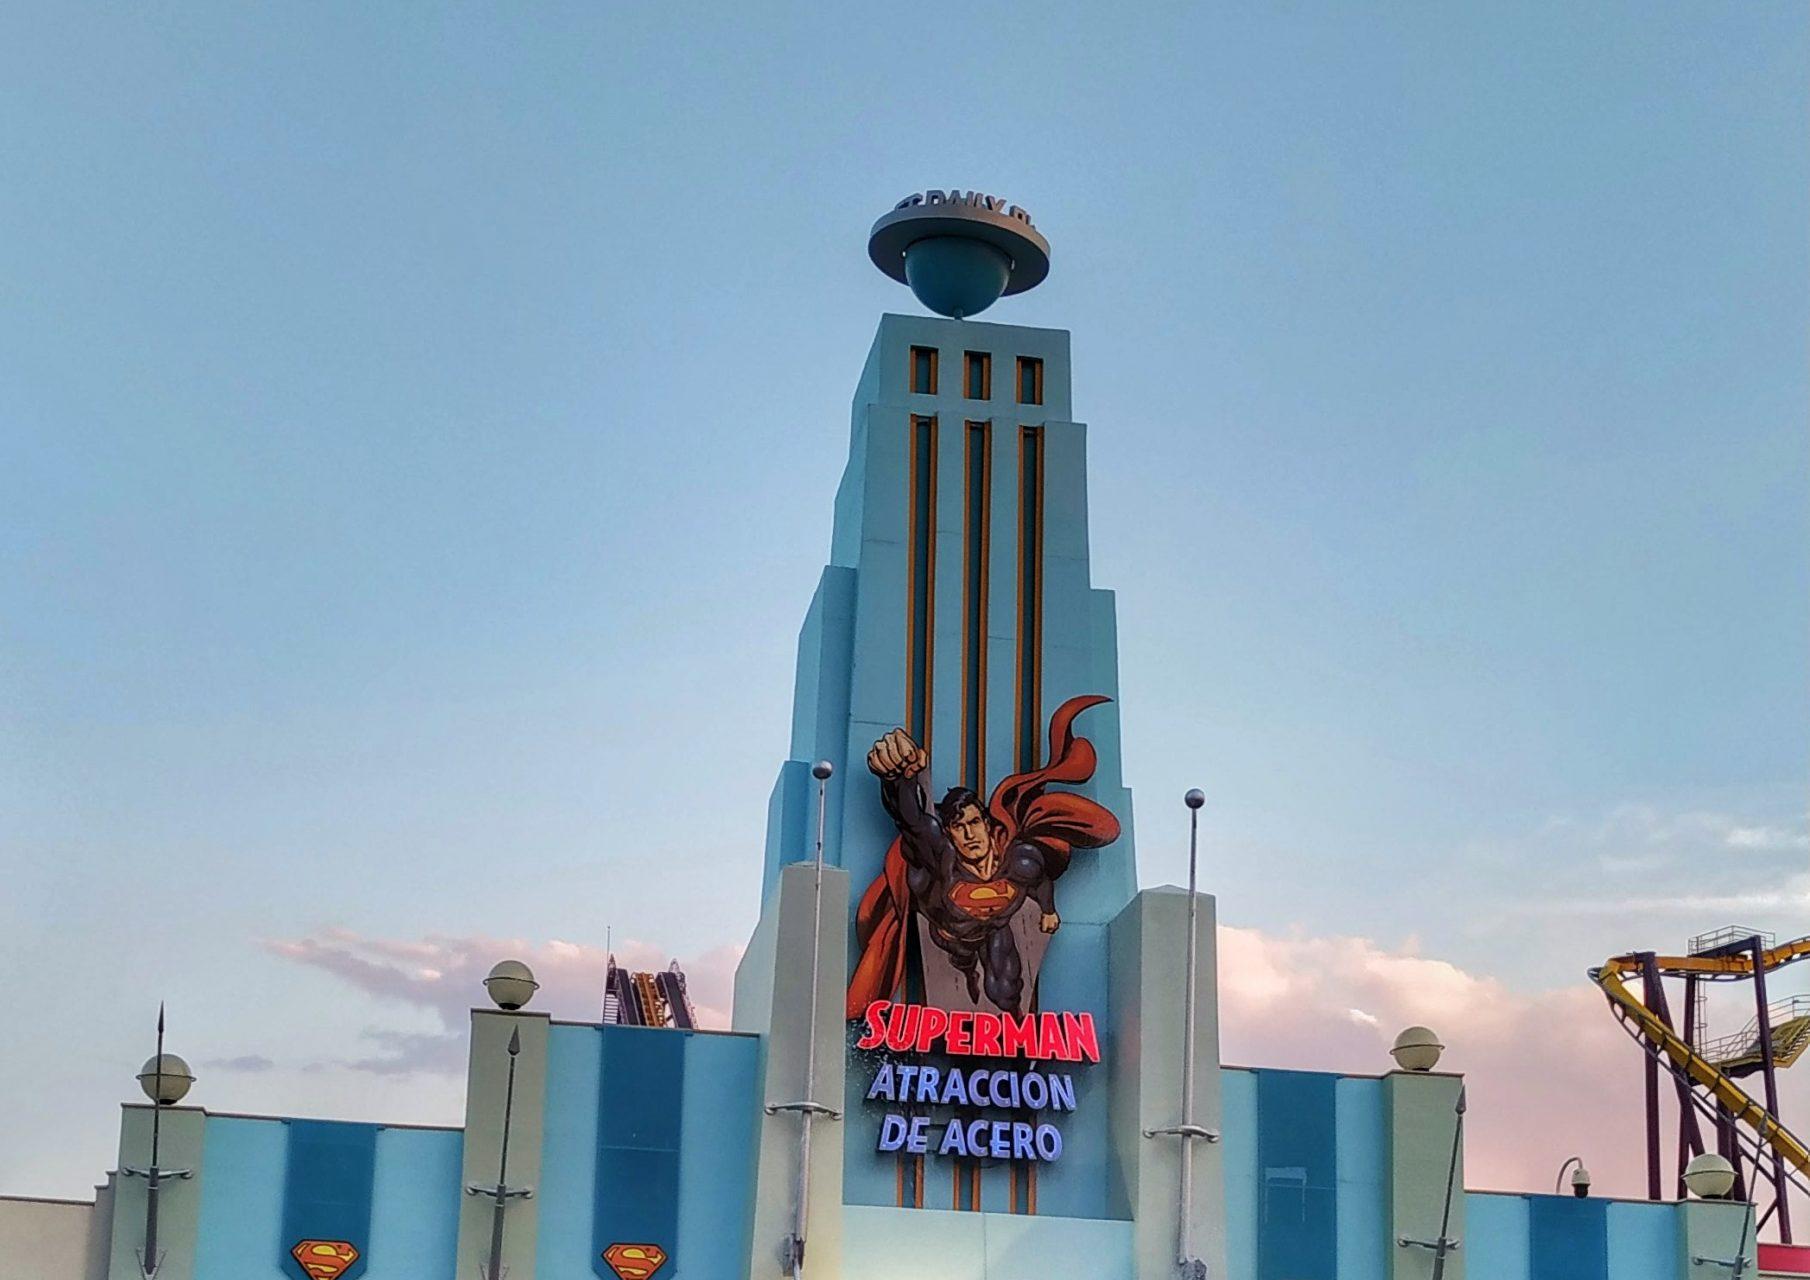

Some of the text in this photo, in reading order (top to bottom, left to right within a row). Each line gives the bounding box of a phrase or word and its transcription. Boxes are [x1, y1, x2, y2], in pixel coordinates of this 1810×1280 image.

[924, 189, 1006, 212] DAILY
[857, 1000, 1101, 1063] SUPERMAN
[866, 1061, 1077, 1112] ATRACCIÓN
[878, 1114, 1063, 1162] DE ACERO
